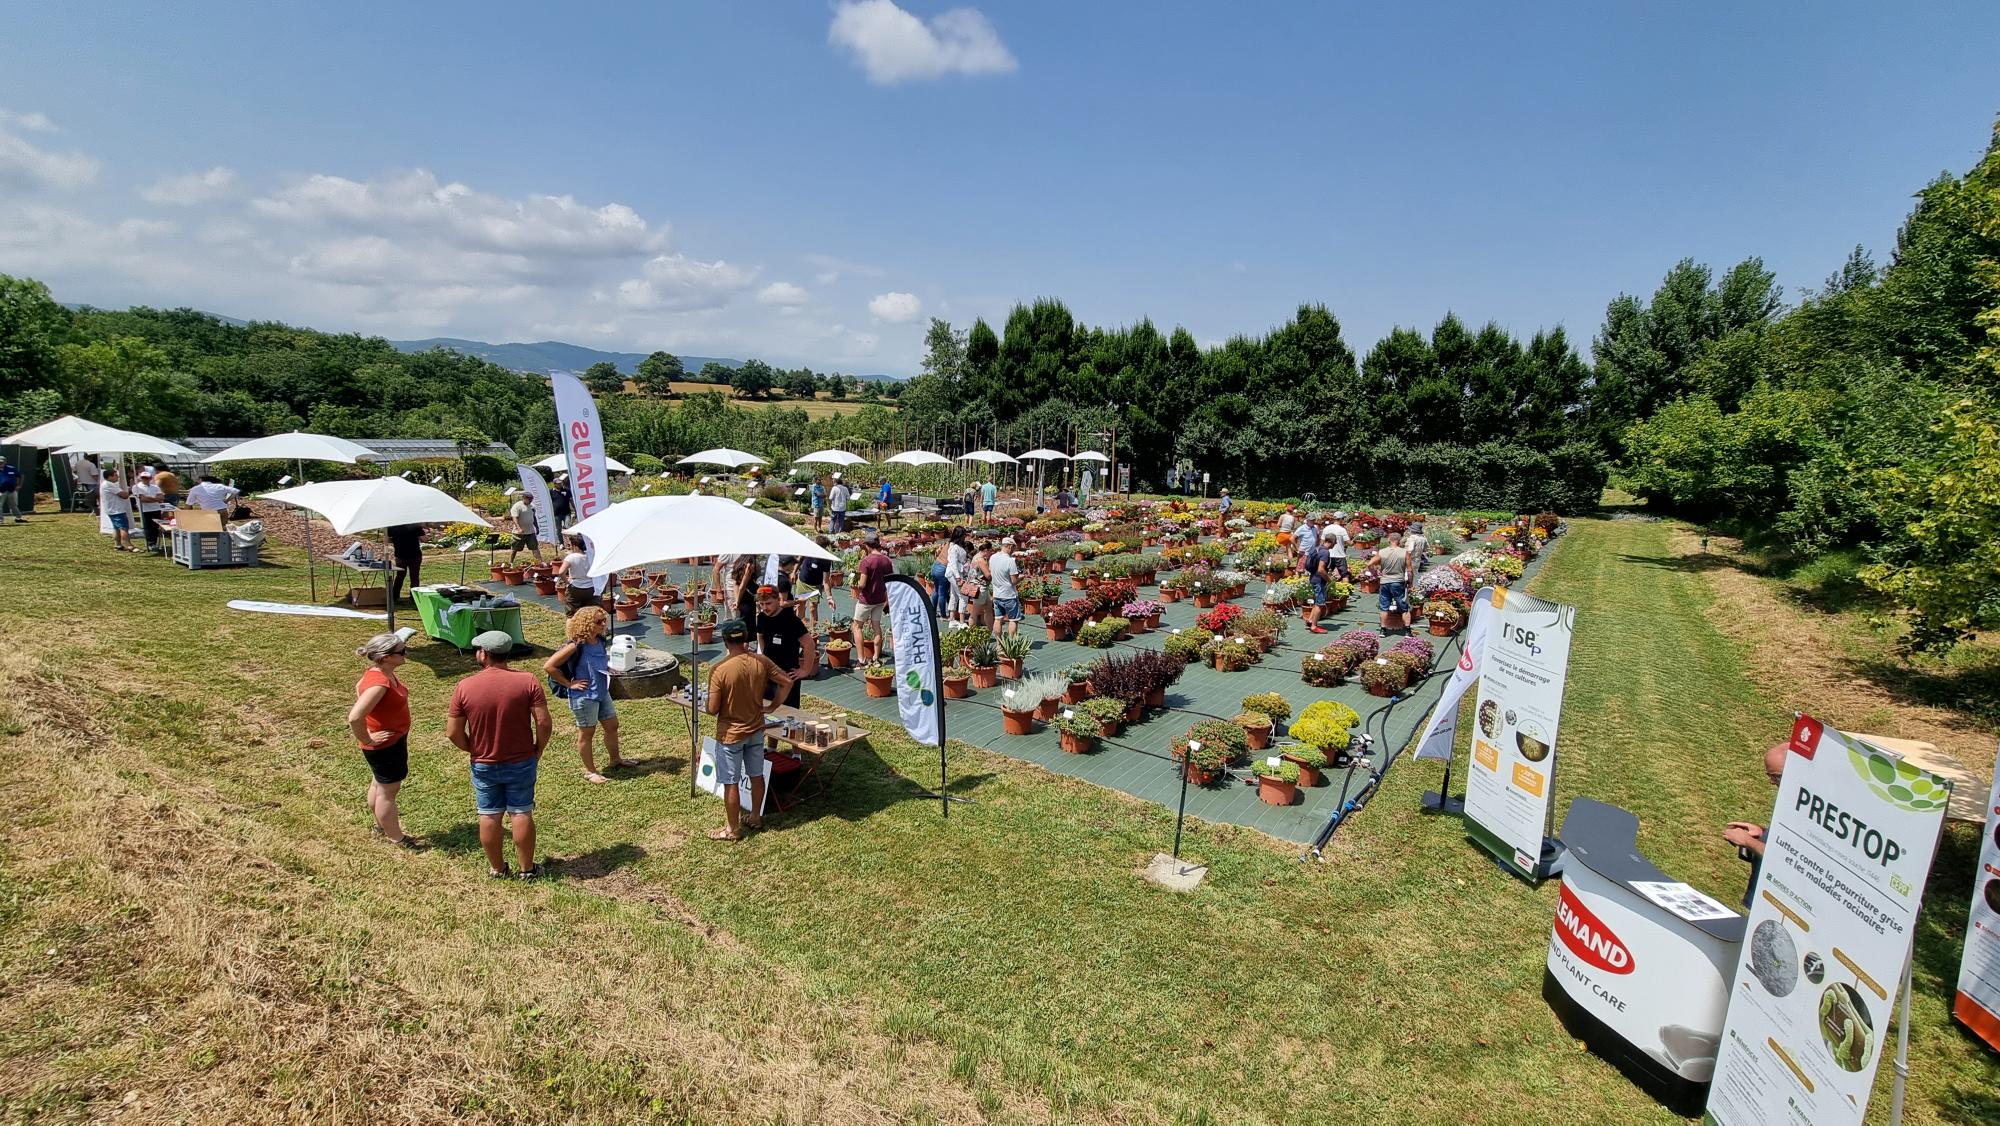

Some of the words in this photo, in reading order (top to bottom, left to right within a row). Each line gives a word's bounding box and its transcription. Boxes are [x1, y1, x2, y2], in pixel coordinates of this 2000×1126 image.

[908, 604, 927, 665] PHYLAE
[1491, 654, 1512, 670] Favorisez
[1512, 663, 1518, 672] le
[1518, 666, 1551, 684] démarrage
[1505, 669, 1514, 677] vos
[1514, 672, 1537, 687] cultures
[1772, 877, 1791, 895] MODES
[1790, 889, 1813, 912] D'ACTION
[1775, 835, 1799, 857] Luttez
[1799, 853, 1824, 875] contre
[1825, 869, 1834, 882] la
[1834, 879, 1880, 916] pourriture
[1880, 911, 1904, 935] grise
[1784, 855, 1793, 866] et
[1793, 861, 1804, 874] les
[1805, 871, 1842, 902] maladies
[1842, 898, 1886, 936] racinaires
[1562, 955, 1592, 987] PLANT
[1592, 984, 1628, 1013] CARE
